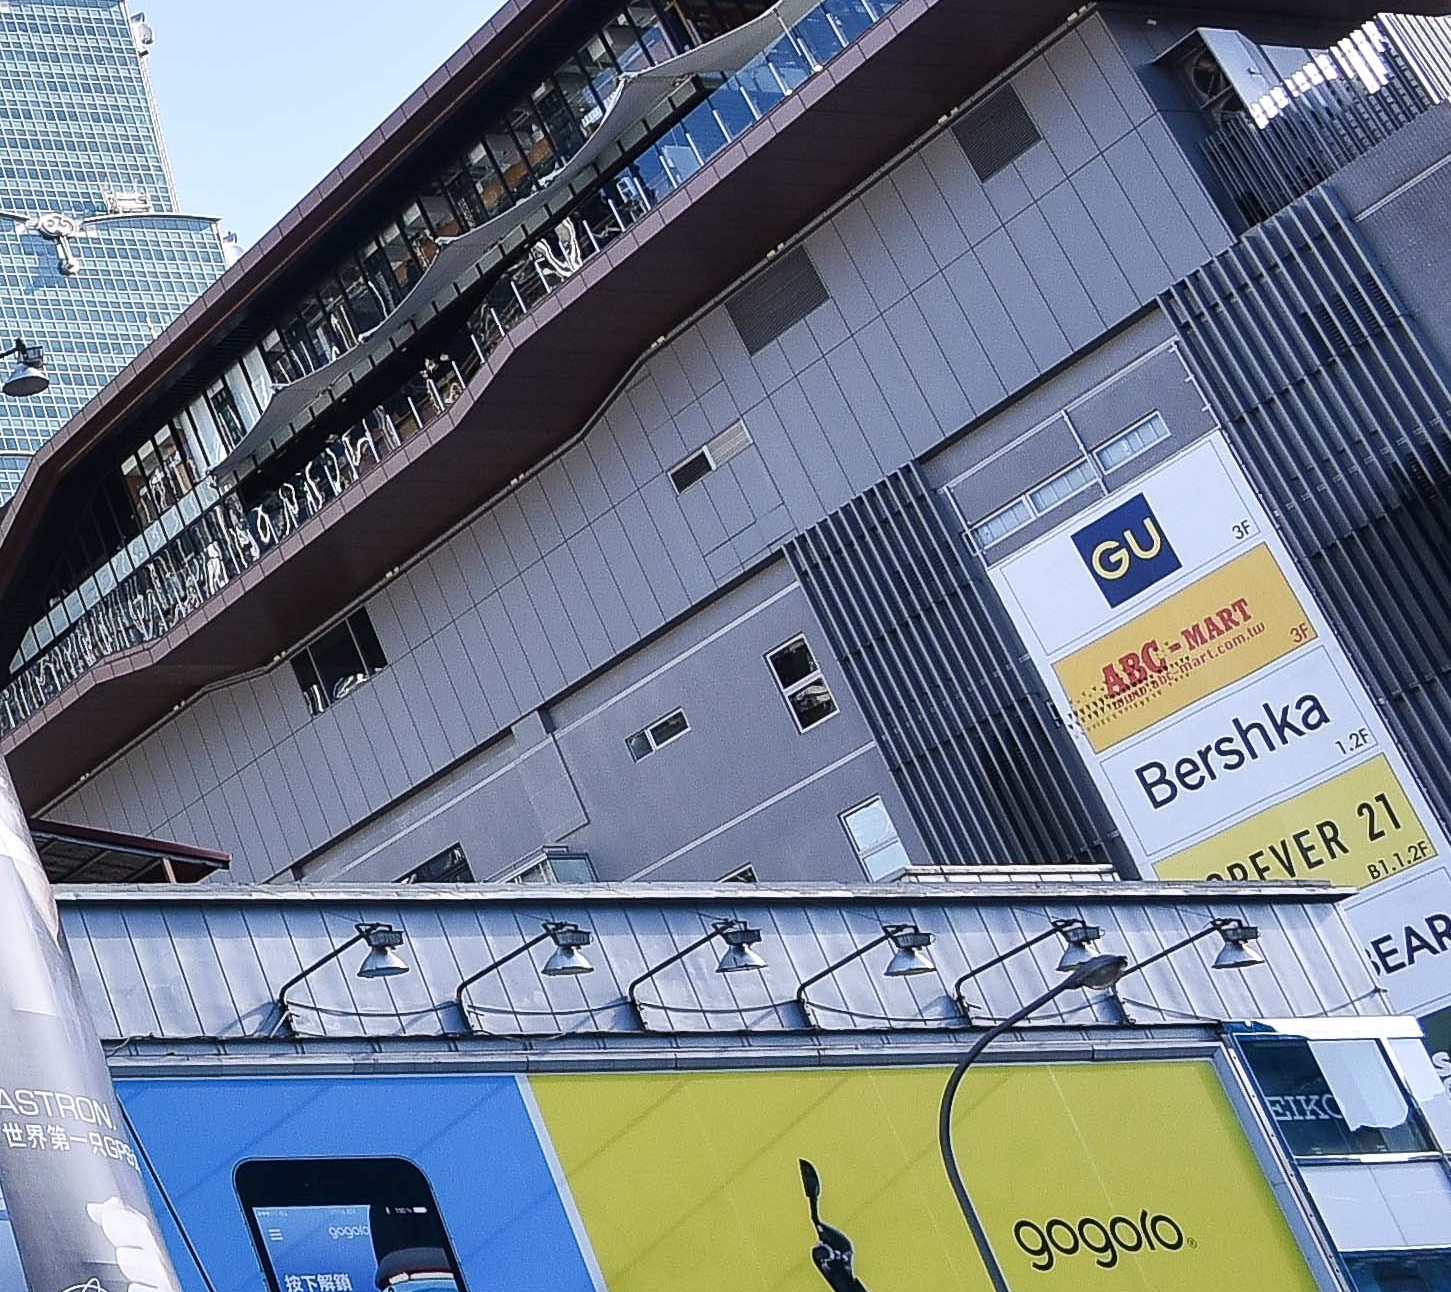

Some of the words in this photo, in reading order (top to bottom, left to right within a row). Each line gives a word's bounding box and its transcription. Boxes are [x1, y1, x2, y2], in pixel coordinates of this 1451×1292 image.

[1232, 517, 1252, 540] 3F
[1090, 519, 1163, 580] GU
[1289, 622, 1309, 643] 3F
[1134, 693, 1331, 809] Bershka
[1357, 792, 1401, 841] 21
[285, 1273, 353, 1292] 按下解鎖
